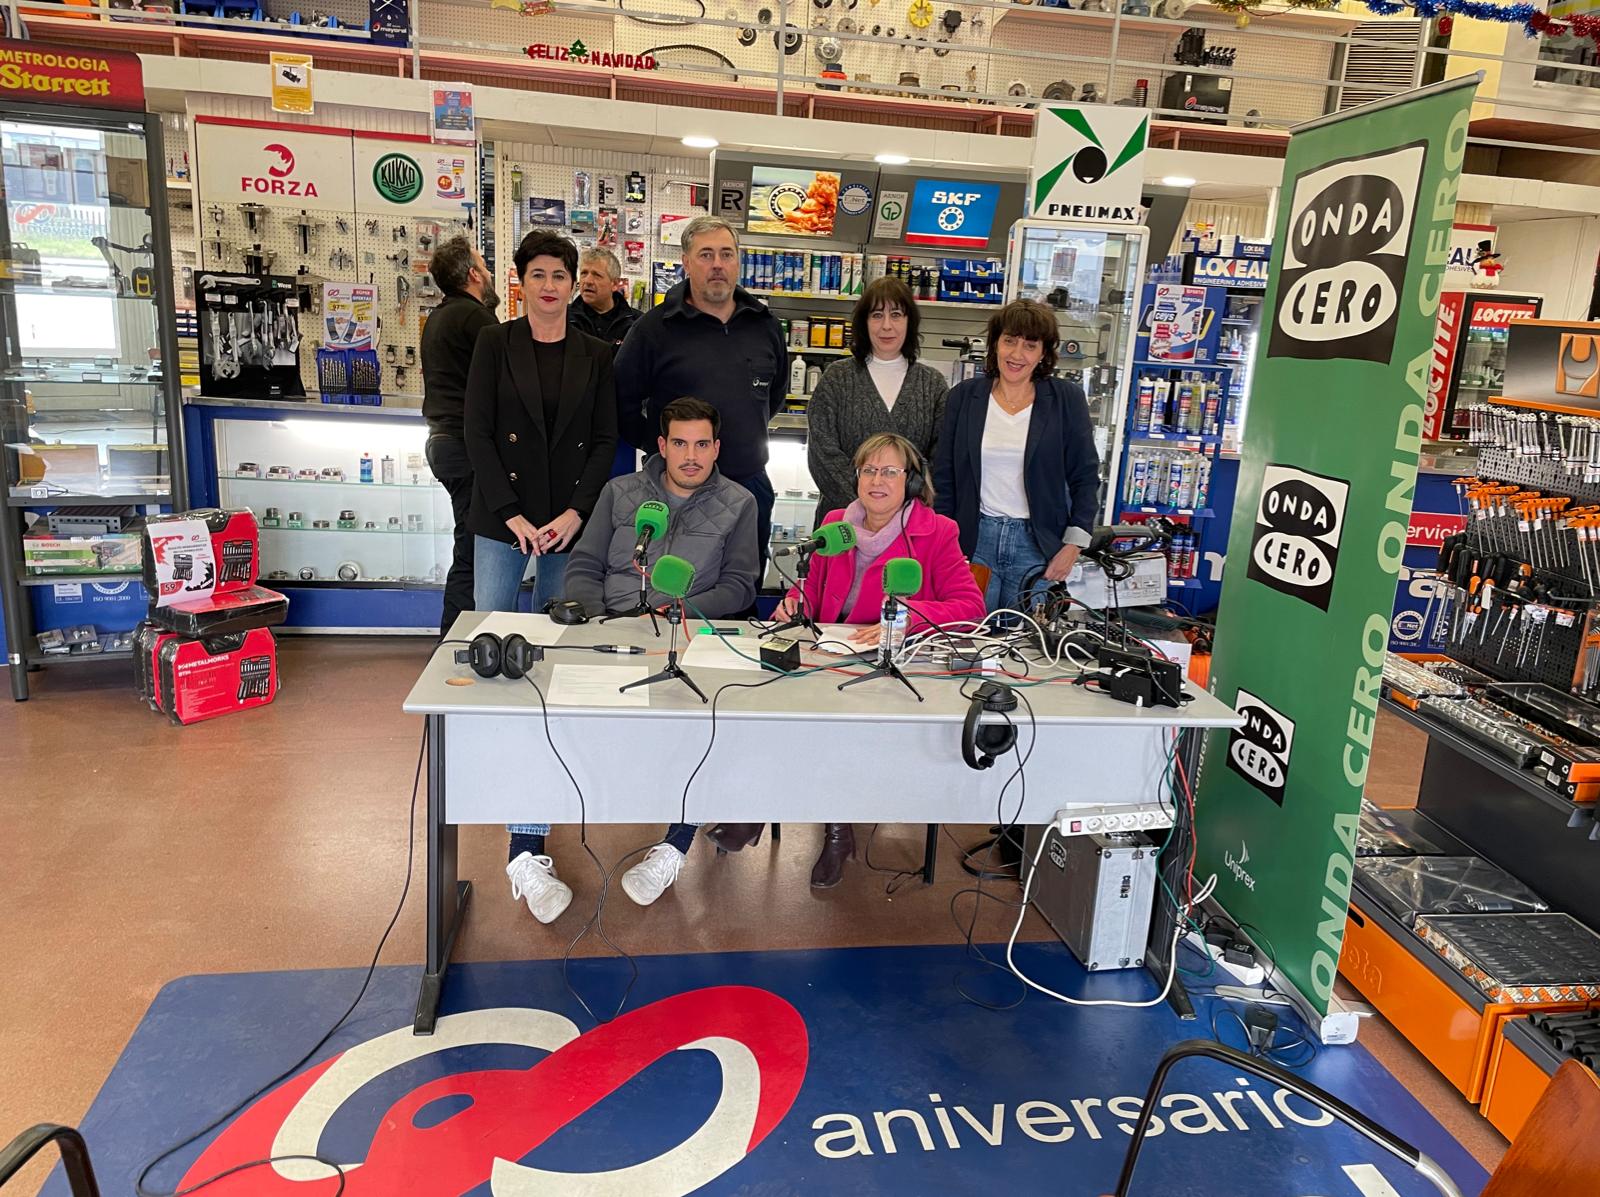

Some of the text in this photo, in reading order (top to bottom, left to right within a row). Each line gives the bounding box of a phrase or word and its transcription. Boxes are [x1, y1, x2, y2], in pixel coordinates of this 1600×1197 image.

[0, 49, 110, 73] METROLOGIA
[528, 44, 655, 70] FELIZ NAVIDAD
[0, 63, 111, 97] Starrett
[241, 176, 319, 198] FORZA
[382, 158, 416, 185] KUKKO
[932, 190, 982, 207] SKF
[1049, 203, 1136, 221] PNEUMAX
[1301, 198, 1392, 247] ONDA
[1193, 278, 1235, 287] ENGINEERING
[1194, 257, 1269, 280] LOXEAL
[1292, 280, 1382, 325] CERO
[1268, 490, 1328, 529] ONDA
[1263, 538, 1320, 581] CERO
[1241, 709, 1282, 750] ONDA
[1238, 743, 1276, 783] CERO
[1224, 850, 1256, 892] Uniprex
[1310, 812, 1361, 1003] ONDA
[812, 1077, 1336, 1160] aniversario
